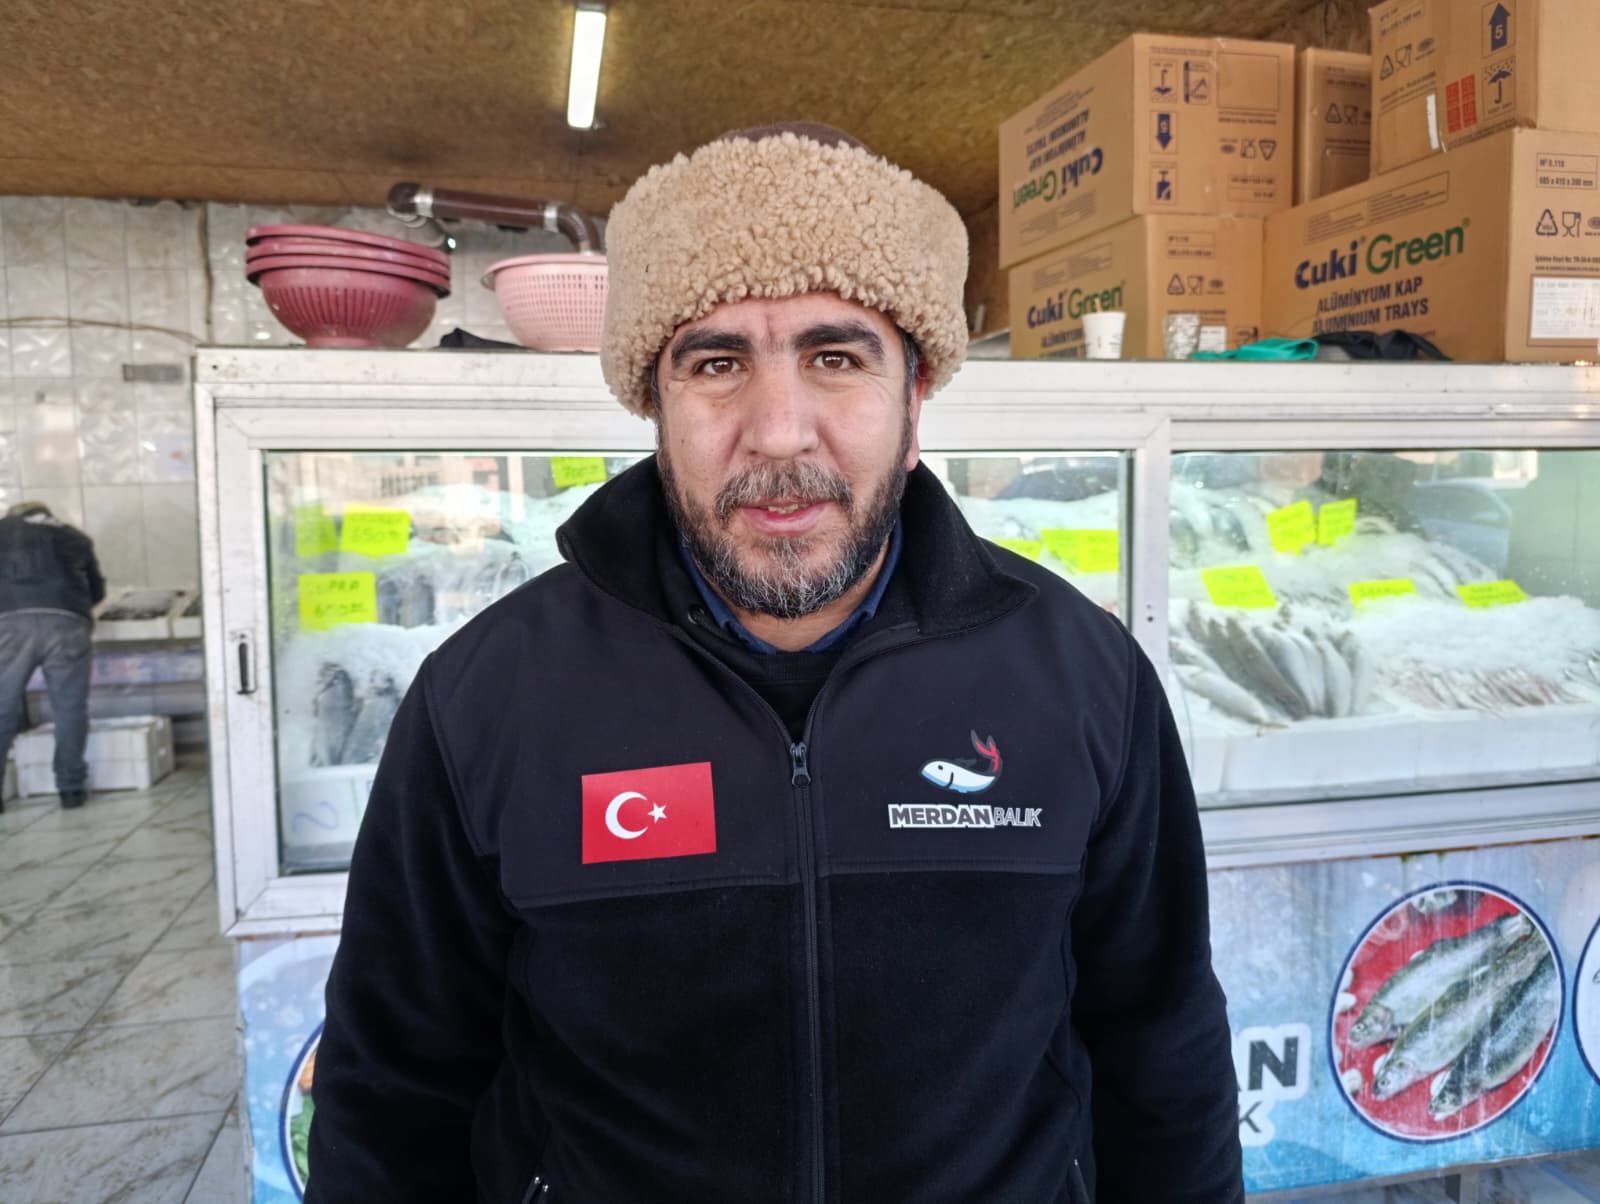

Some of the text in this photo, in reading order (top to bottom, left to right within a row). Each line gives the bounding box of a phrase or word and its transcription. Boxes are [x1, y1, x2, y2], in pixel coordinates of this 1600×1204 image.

[1495, 24, 1504, 40] 5
[1062, 147, 1104, 196] Cuki
[1295, 241, 1358, 289] Cuki
[1366, 225, 1464, 275] Green
[1027, 286, 1122, 329] Cuki Green
[1318, 275, 1424, 314] ALÜMİNYUM KAP
[1313, 298, 1429, 336] ALUMINIUM TRAYS
